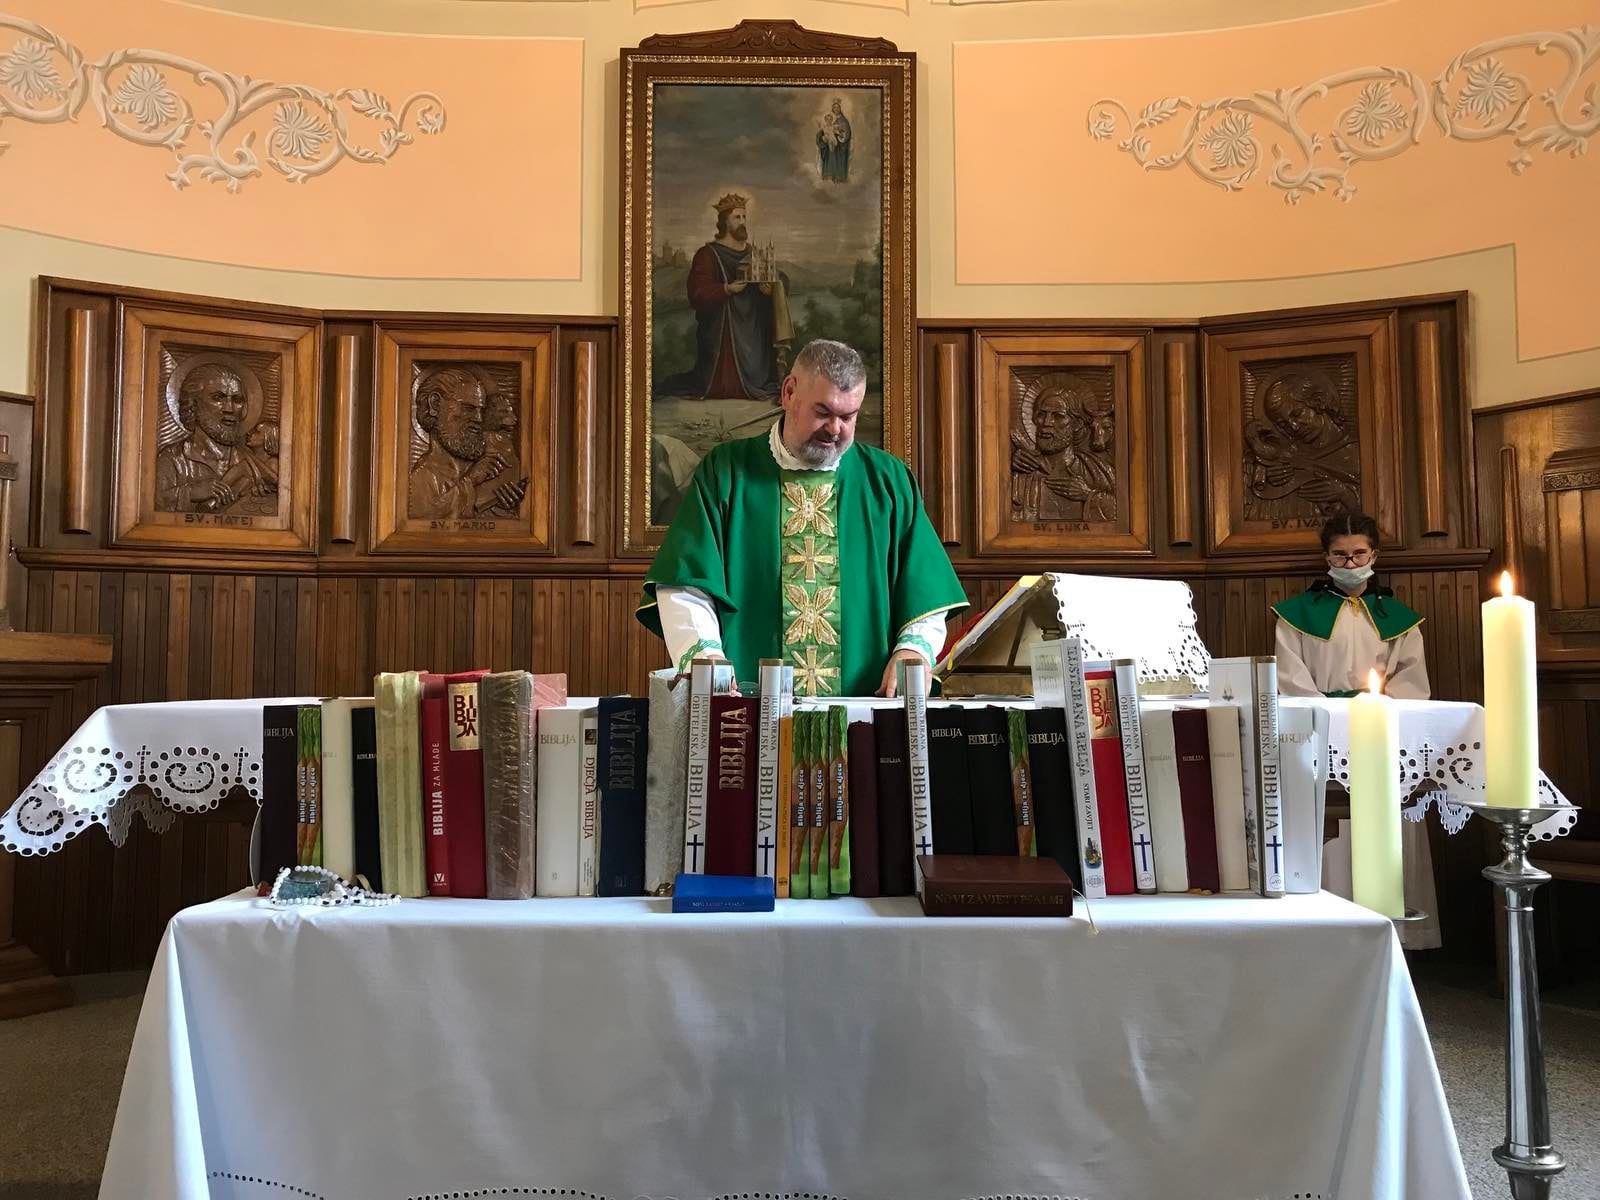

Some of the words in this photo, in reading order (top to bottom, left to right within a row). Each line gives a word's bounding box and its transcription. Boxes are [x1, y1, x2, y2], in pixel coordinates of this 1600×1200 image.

[185, 513, 209, 523] SV.
[215, 515, 253, 527] MATEJ
[431, 521, 449, 529] SV.
[454, 521, 496, 530] MARKO
[1033, 523, 1052, 532] SV.
[1056, 523, 1089, 532] LUKA
[1271, 520, 1293, 529] SV.
[264, 727, 295, 739] BIBLIJA
[540, 734, 576, 746] BIBLIJA
[690, 695, 700, 757] OBITELJSKA
[699, 696, 709, 749] ILUSTRIRANA
[719, 706, 752, 790] BIBLIJA
[760, 696, 770, 758] OBITELJSKA
[769, 696, 778, 751] ILUSTRIRANA
[909, 696, 919, 759] OBITELJSKA
[918, 696, 926, 750] ILUSTRIRANA
[931, 728, 963, 738] BIBLIJA
[968, 734, 1005, 746] BIBLIJA
[1028, 733, 1065, 745] BIBLIJA
[1067, 646, 1085, 729] ILUSTRIRANA
[1076, 732, 1090, 776] BIBLIJA
[1085, 804, 1093, 830] ZAVJET
[1120, 696, 1132, 758] OBITELJSKA
[1129, 696, 1140, 749] ILUSTRIRANA
[1260, 694, 1270, 757] OBITELJSKA
[432, 742, 440, 772] MLADE
[609, 709, 641, 790] BIBLIJA
[433, 775, 441, 787] ZA
[688, 764, 704, 830] BIBLIJA
[759, 766, 774, 832] BIBLIJA
[912, 765, 928, 831] BIBLIJA
[1127, 764, 1146, 829] BIBLIJA
[1263, 764, 1279, 831] BIBLIJA
[432, 790, 444, 836] BIBLIJA
[583, 801, 595, 839] BIBLIJA
[797, 801, 805, 826] Biblija
[815, 802, 823, 827] Biblija
